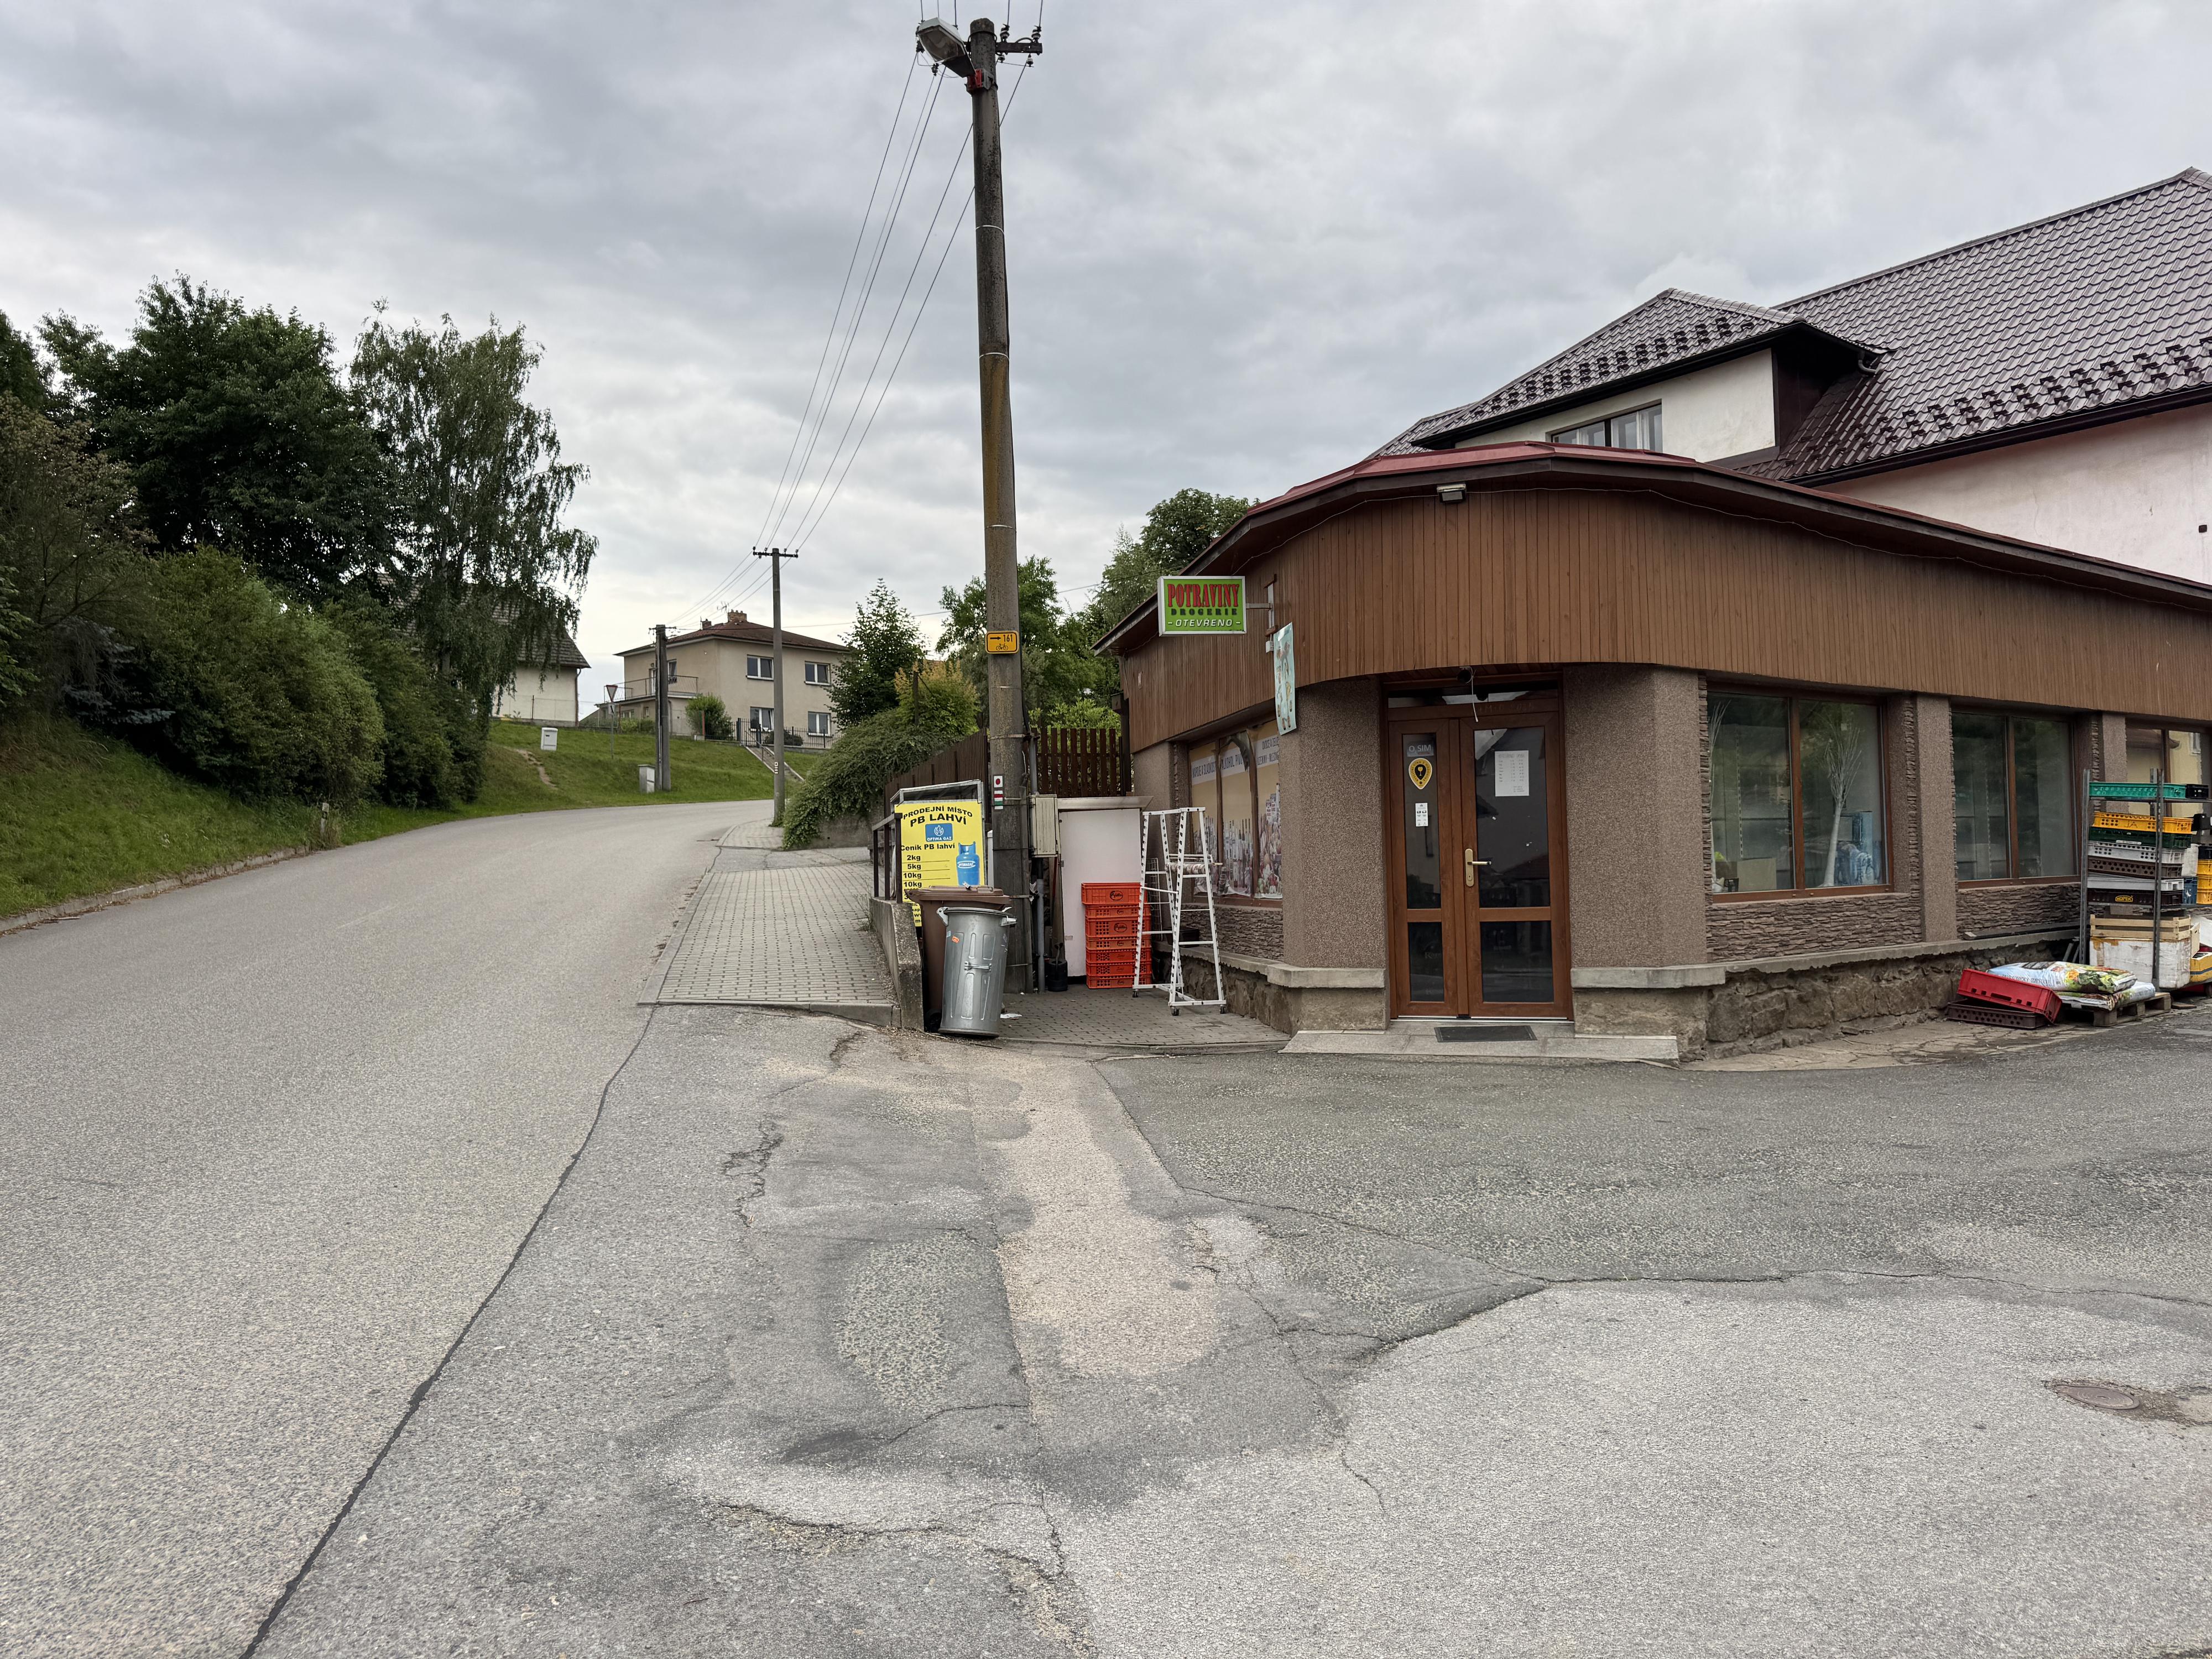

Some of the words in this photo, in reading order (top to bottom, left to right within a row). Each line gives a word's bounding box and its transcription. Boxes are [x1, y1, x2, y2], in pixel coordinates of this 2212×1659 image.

[1167, 583, 1239, 607] POTRAVINY
[1176, 618, 1232, 627] OTEVŘENO
[1417, 744, 1431, 752] SIM
[903, 805, 944, 820] PRODEJNÍ
[947, 806, 973, 817] MÍSTO
[910, 817, 925, 827] PB
[930, 813, 967, 825] LAHVÍ
